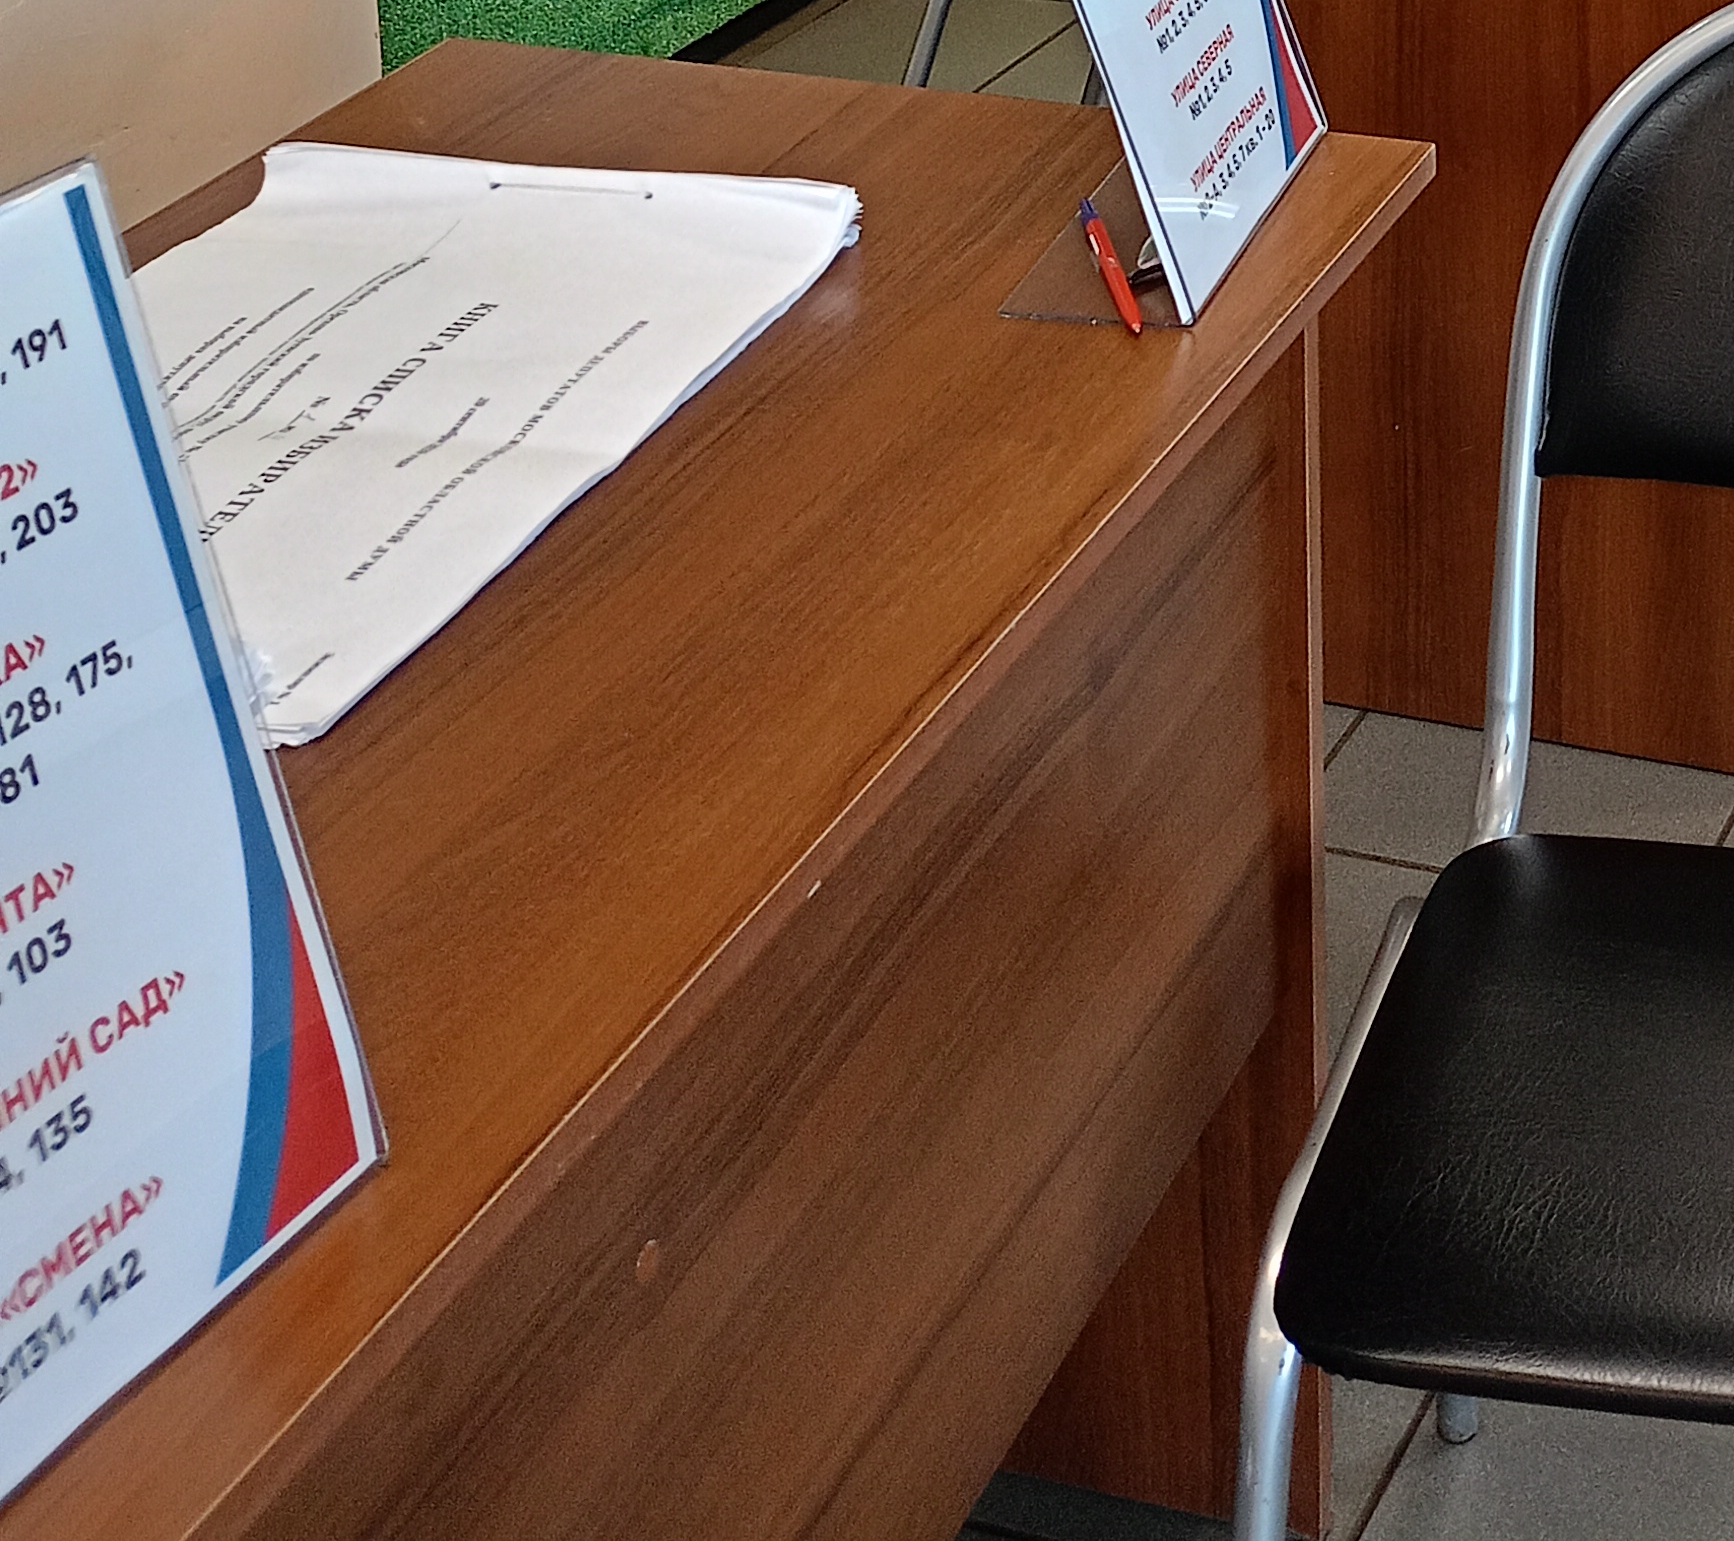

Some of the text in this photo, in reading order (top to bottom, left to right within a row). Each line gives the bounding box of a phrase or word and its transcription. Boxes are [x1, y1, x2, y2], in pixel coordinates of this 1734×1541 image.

[1171, 23, 1235, 108] УЛИЦА СЕВЕРНАЯ
[1190, 85, 1267, 193] УЛИЦА ЦЕНТРАЛЬНАЯ
[11, 318, 68, 371] 191
[419, 301, 500, 353] КНИГА
[602, 319, 650, 355] ВЫБОРЫ
[329, 356, 427, 434] СПИСКА
[538, 354, 605, 413] ДЕПУТАТОВ
[12, 488, 79, 552] 203
[386, 475, 465, 546] ОБЛАСТНОЙ
[344, 545, 391, 582] ДУМЫ
[65, 638, 134, 700] 175,
[7, 918, 73, 986] 103
[89, 970, 186, 1055] САД»
[28, 1093, 94, 1164] 135
[77, 1247, 148, 1322] 142
